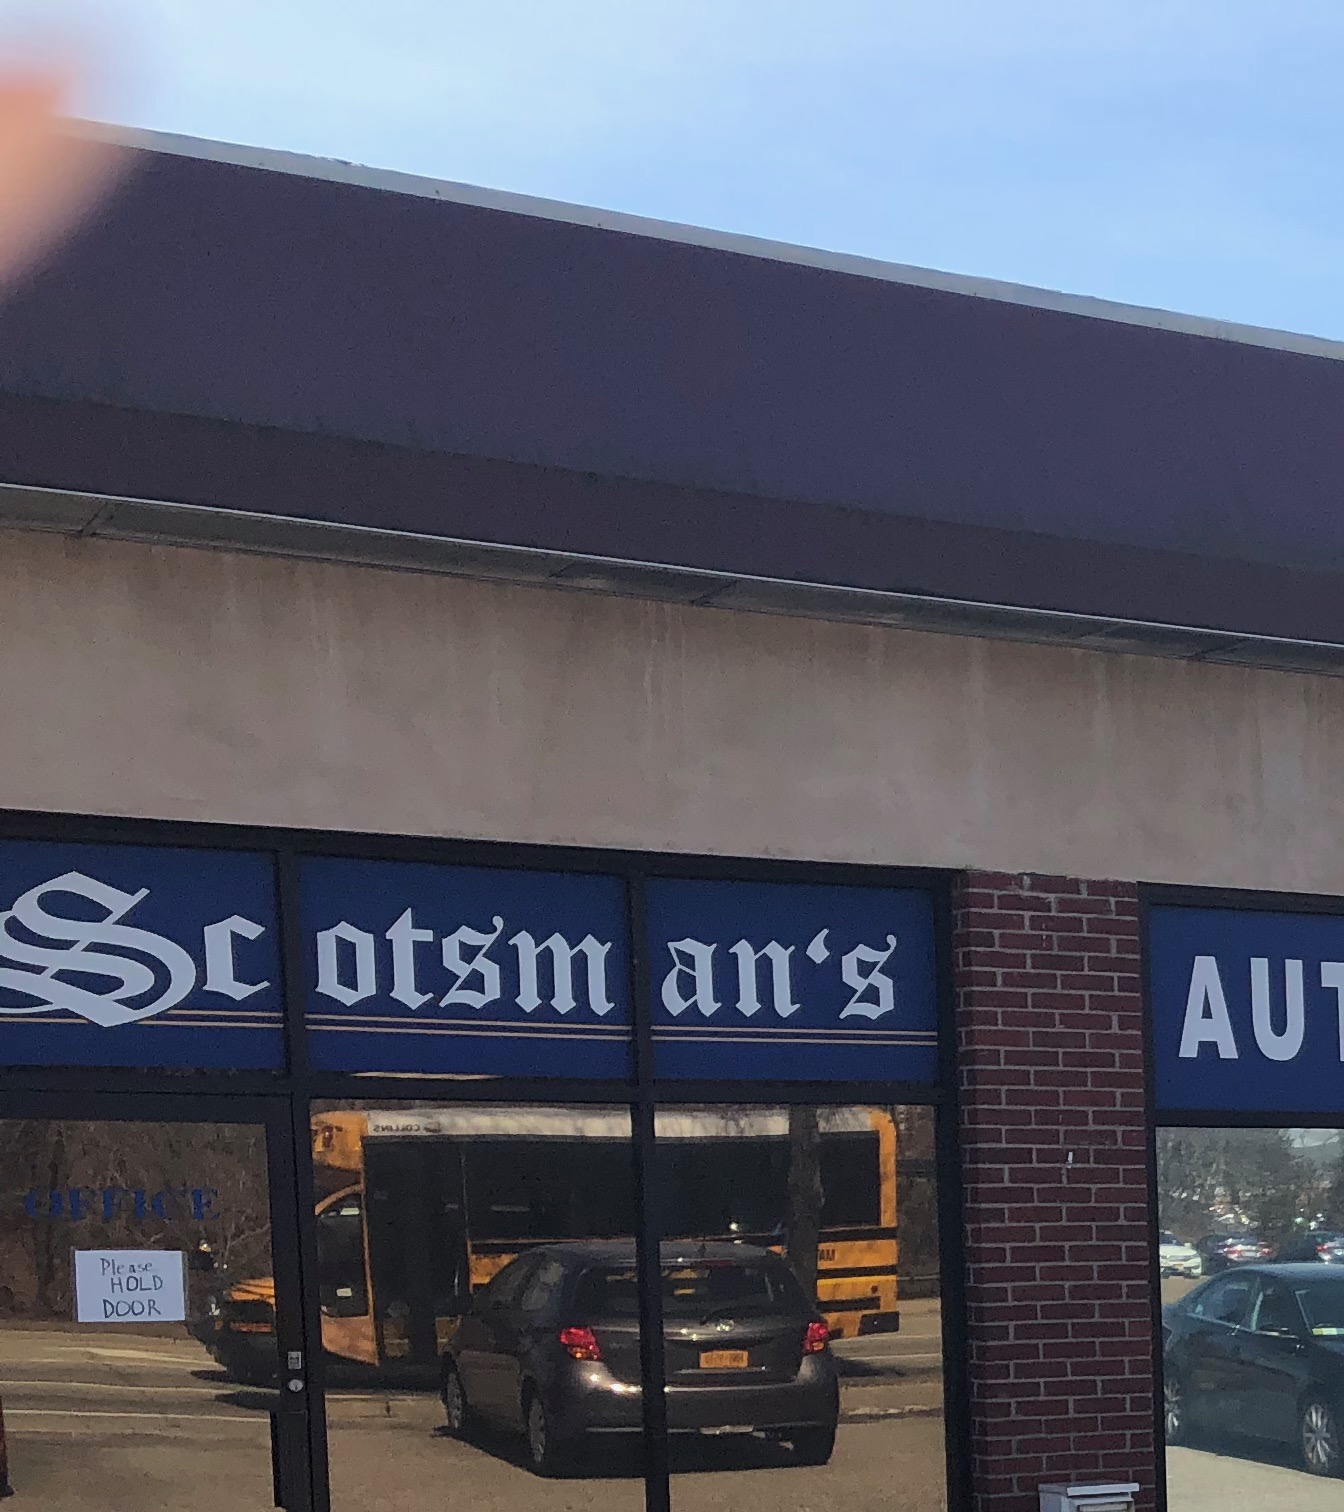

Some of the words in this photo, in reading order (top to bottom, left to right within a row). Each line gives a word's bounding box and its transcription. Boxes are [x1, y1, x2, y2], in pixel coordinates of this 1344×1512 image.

[23, 1184, 220, 1222] OFFICE
[100, 1257, 154, 1276] Please
[110, 1275, 164, 1294] HOLD
[102, 1298, 162, 1319] DOOR
